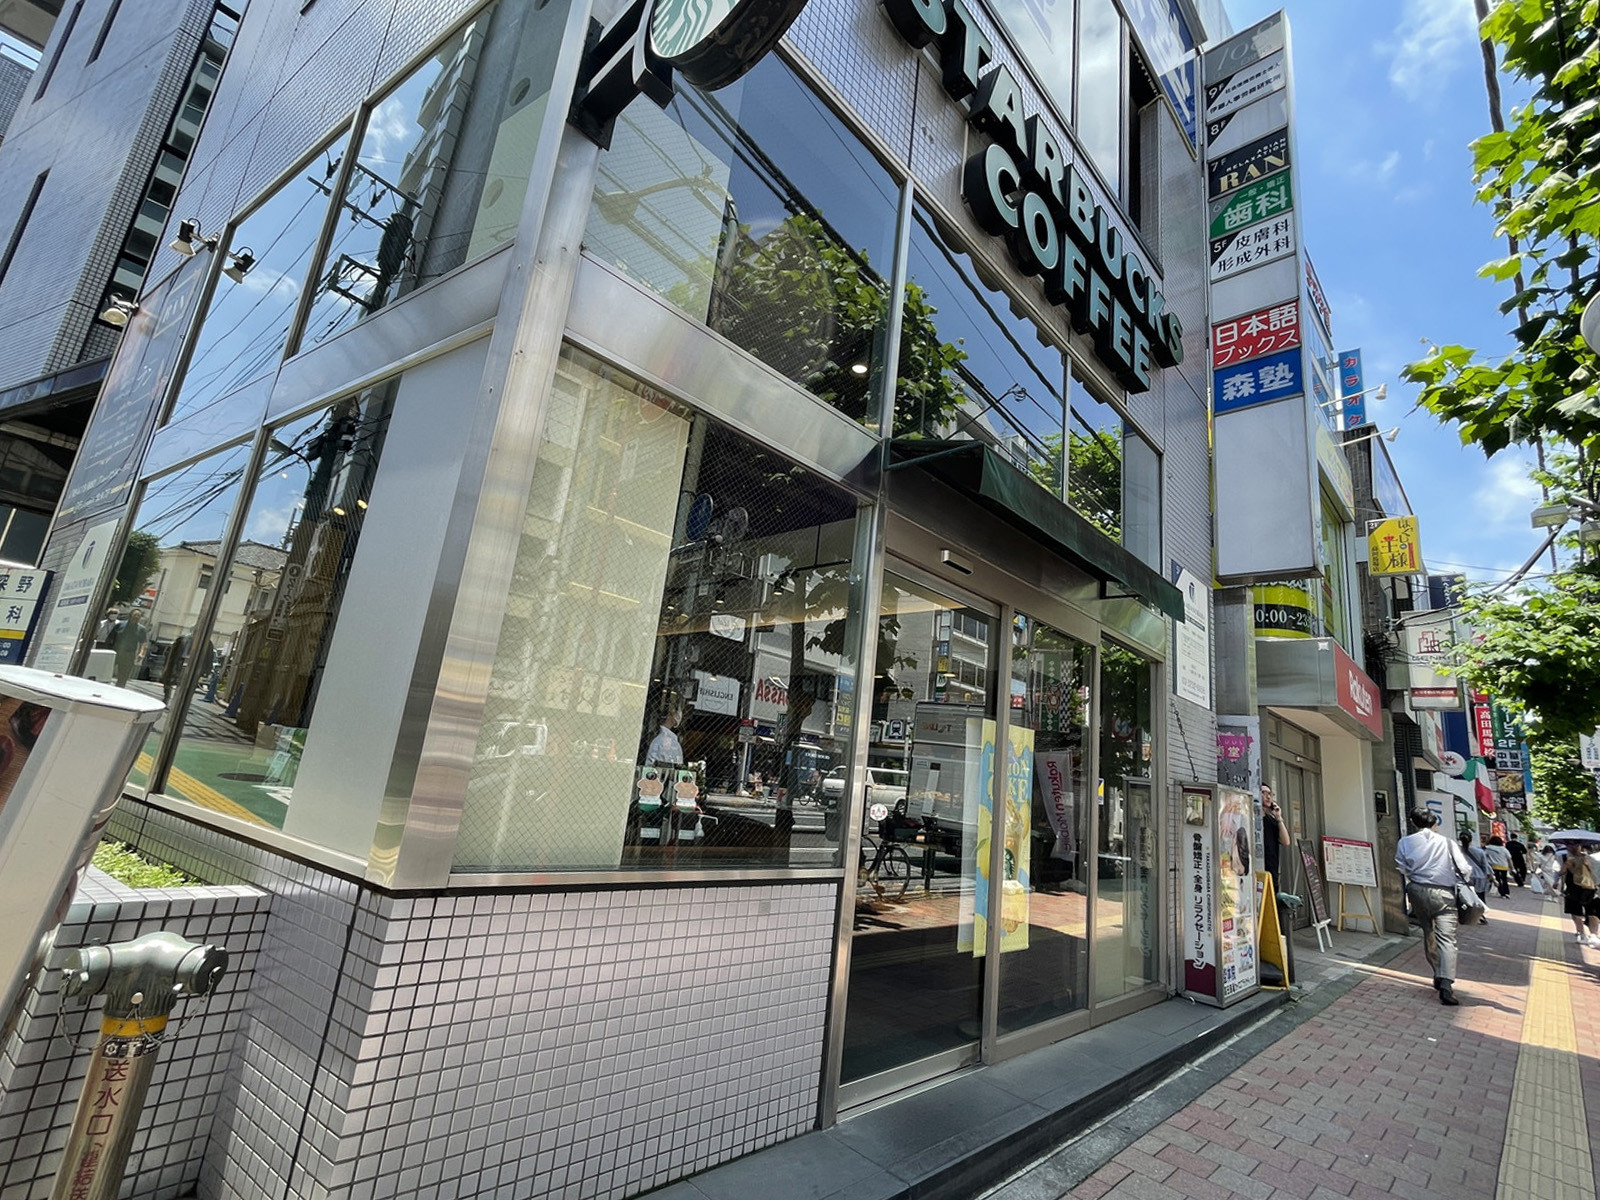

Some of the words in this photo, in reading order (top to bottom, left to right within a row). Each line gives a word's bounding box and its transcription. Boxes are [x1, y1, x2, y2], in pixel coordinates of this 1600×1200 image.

[1211, 120, 1225, 135] 8F
[1256, 137, 1286, 154] ASIAN
[1211, 157, 1227, 172] 7F
[1219, 148, 1287, 192] RAN
[1226, 143, 1286, 172] RELAXATION
[1223, 185, 1288, 231] 歯科
[1213, 240, 1227, 253] 5F
[1235, 218, 1290, 251] 皮膚科
[985, 143, 1151, 392] COFFEE
[1218, 236, 1291, 273] 形成外科
[1216, 302, 1298, 346] 日本語
[1215, 329, 1298, 365] ブックス
[1222, 362, 1294, 401] 森塾
[1344, 356, 1363, 426] カラオケ
[1498, 739, 1517, 748] 2F
[86, 1060, 129, 1136] 送水口
